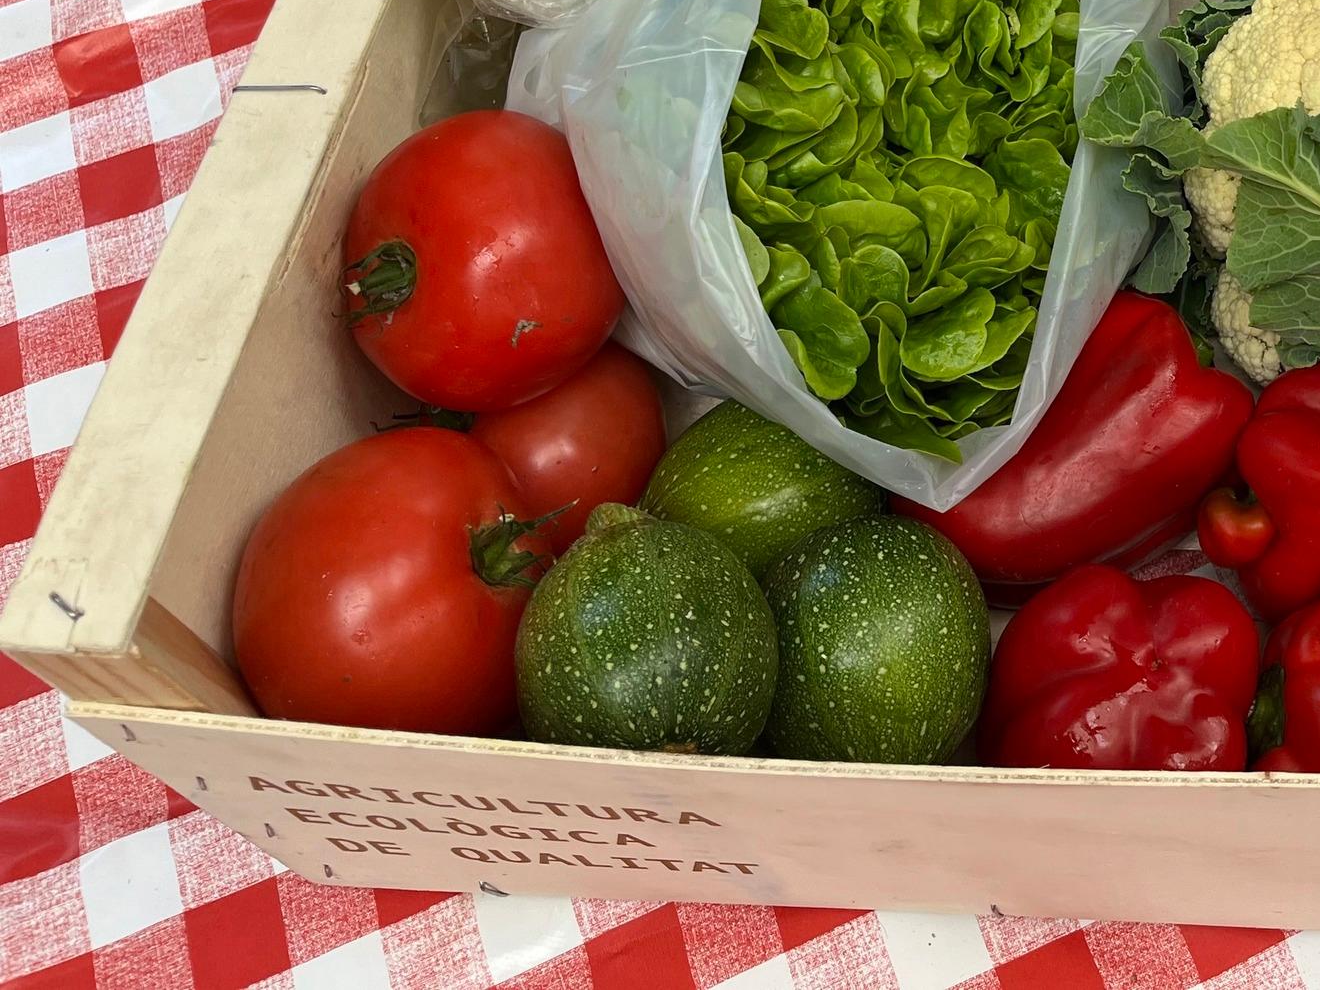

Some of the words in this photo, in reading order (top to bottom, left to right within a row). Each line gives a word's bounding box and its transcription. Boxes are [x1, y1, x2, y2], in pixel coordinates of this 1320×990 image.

[248, 775, 722, 828] AGRICULTURA
[284, 807, 656, 849] ECOLÒGICA
[325, 836, 411, 857] DE
[450, 846, 761, 876] QUALITAT
